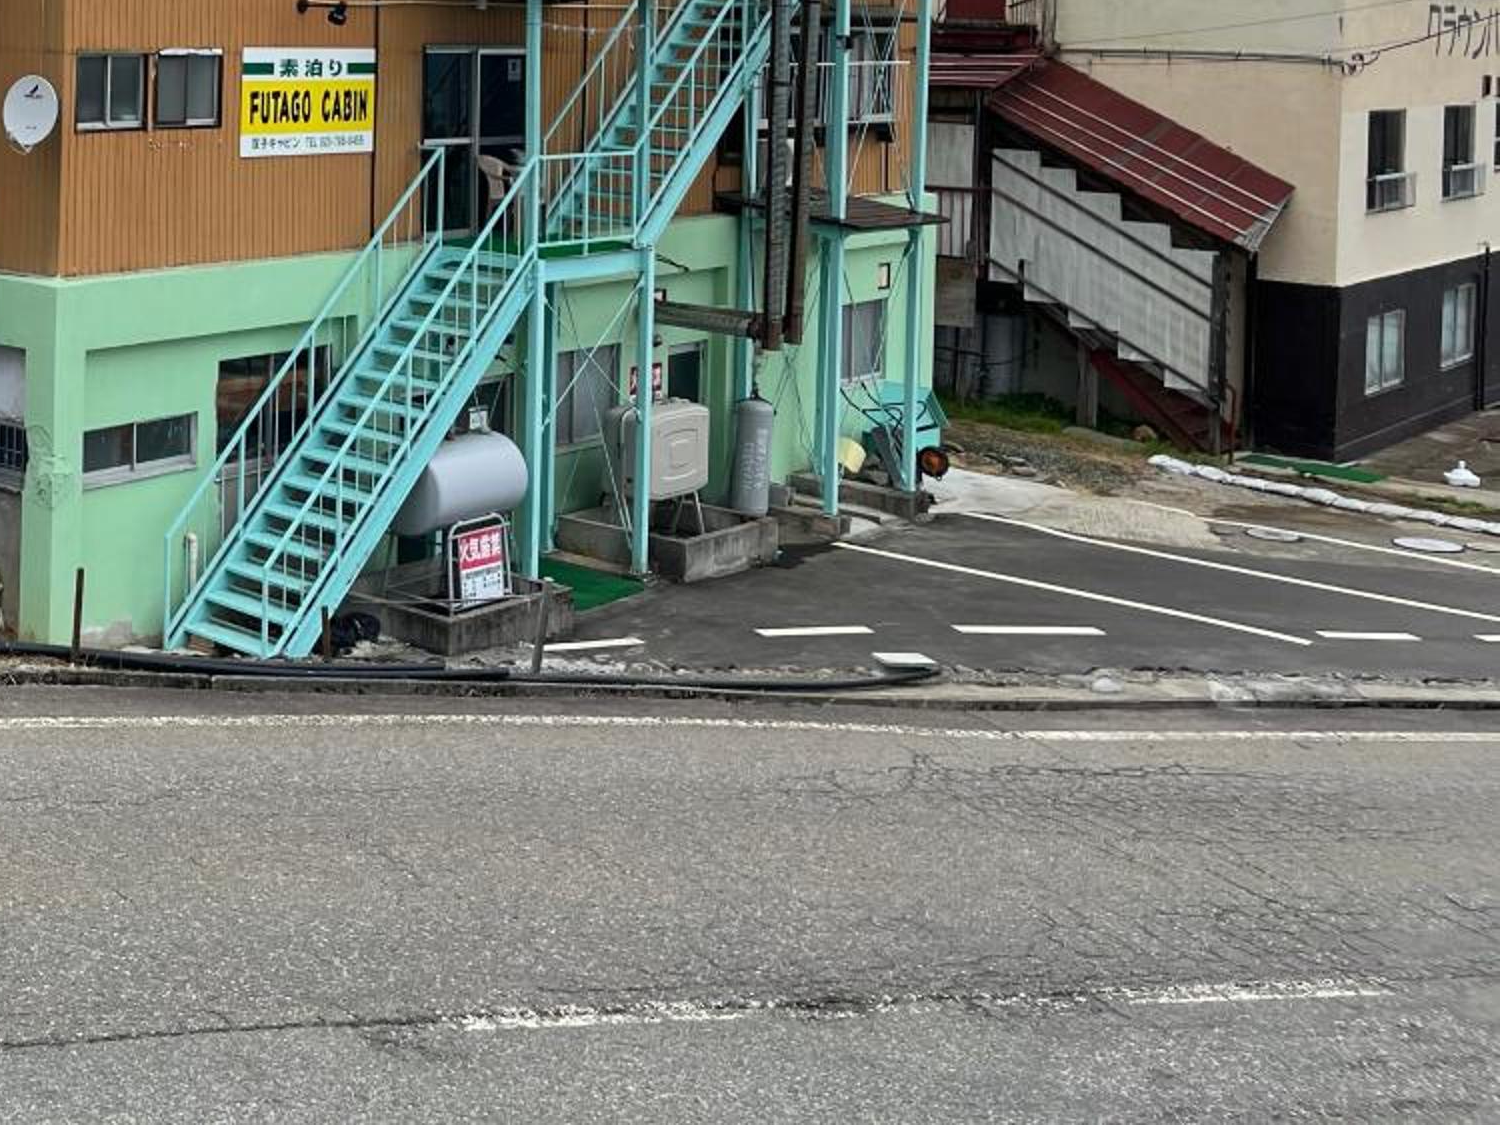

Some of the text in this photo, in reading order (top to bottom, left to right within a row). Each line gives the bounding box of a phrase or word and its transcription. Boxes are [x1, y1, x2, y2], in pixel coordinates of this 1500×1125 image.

[280, 59, 342, 77] 素泊り
[249, 89, 368, 124] FUTAGO CABIN
